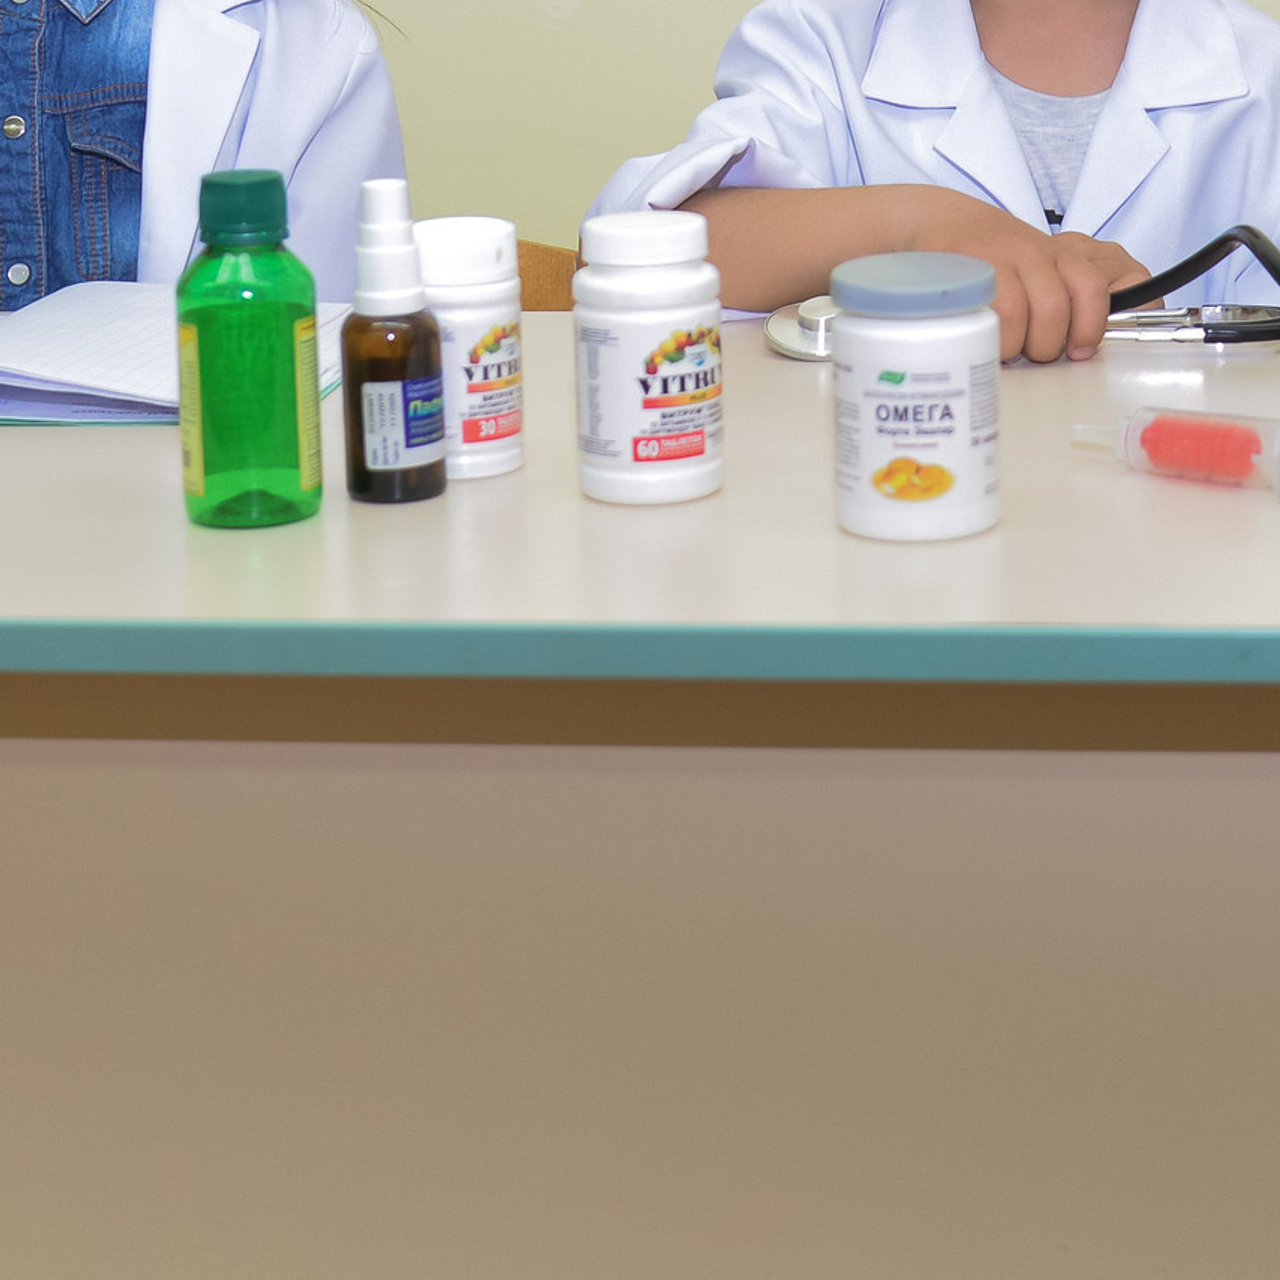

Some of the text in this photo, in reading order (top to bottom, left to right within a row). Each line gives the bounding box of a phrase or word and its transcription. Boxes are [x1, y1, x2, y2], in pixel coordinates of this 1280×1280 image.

[461, 358, 520, 381] VITR
[636, 364, 722, 396] VITRU
[876, 404, 954, 422] ОМЕГА
[479, 419, 497, 437] 30
[636, 439, 660, 458] 60
